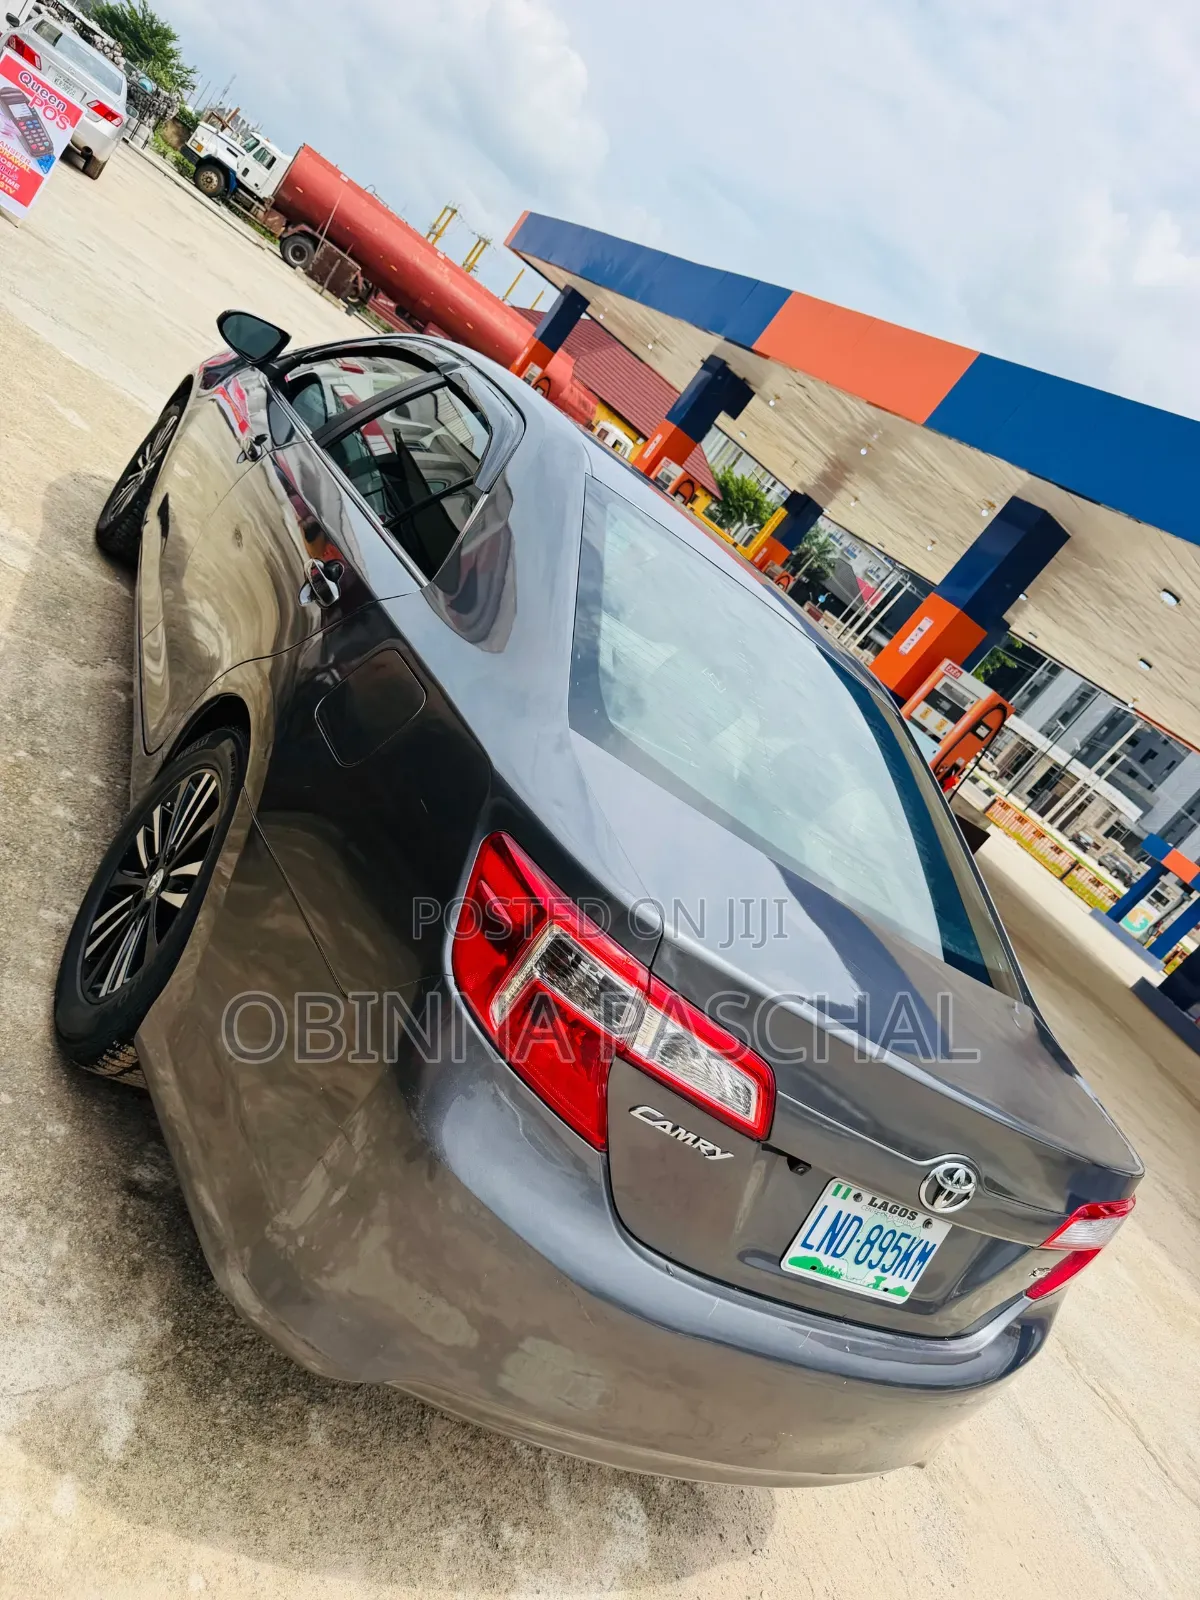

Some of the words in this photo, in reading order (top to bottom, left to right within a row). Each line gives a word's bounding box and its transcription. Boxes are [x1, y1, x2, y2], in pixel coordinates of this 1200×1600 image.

[20, 72, 66, 111] Queen
[28, 95, 70, 130] POS
[629, 1105, 735, 1160] CAMRY
[868, 1197, 918, 1221] LAGOS
